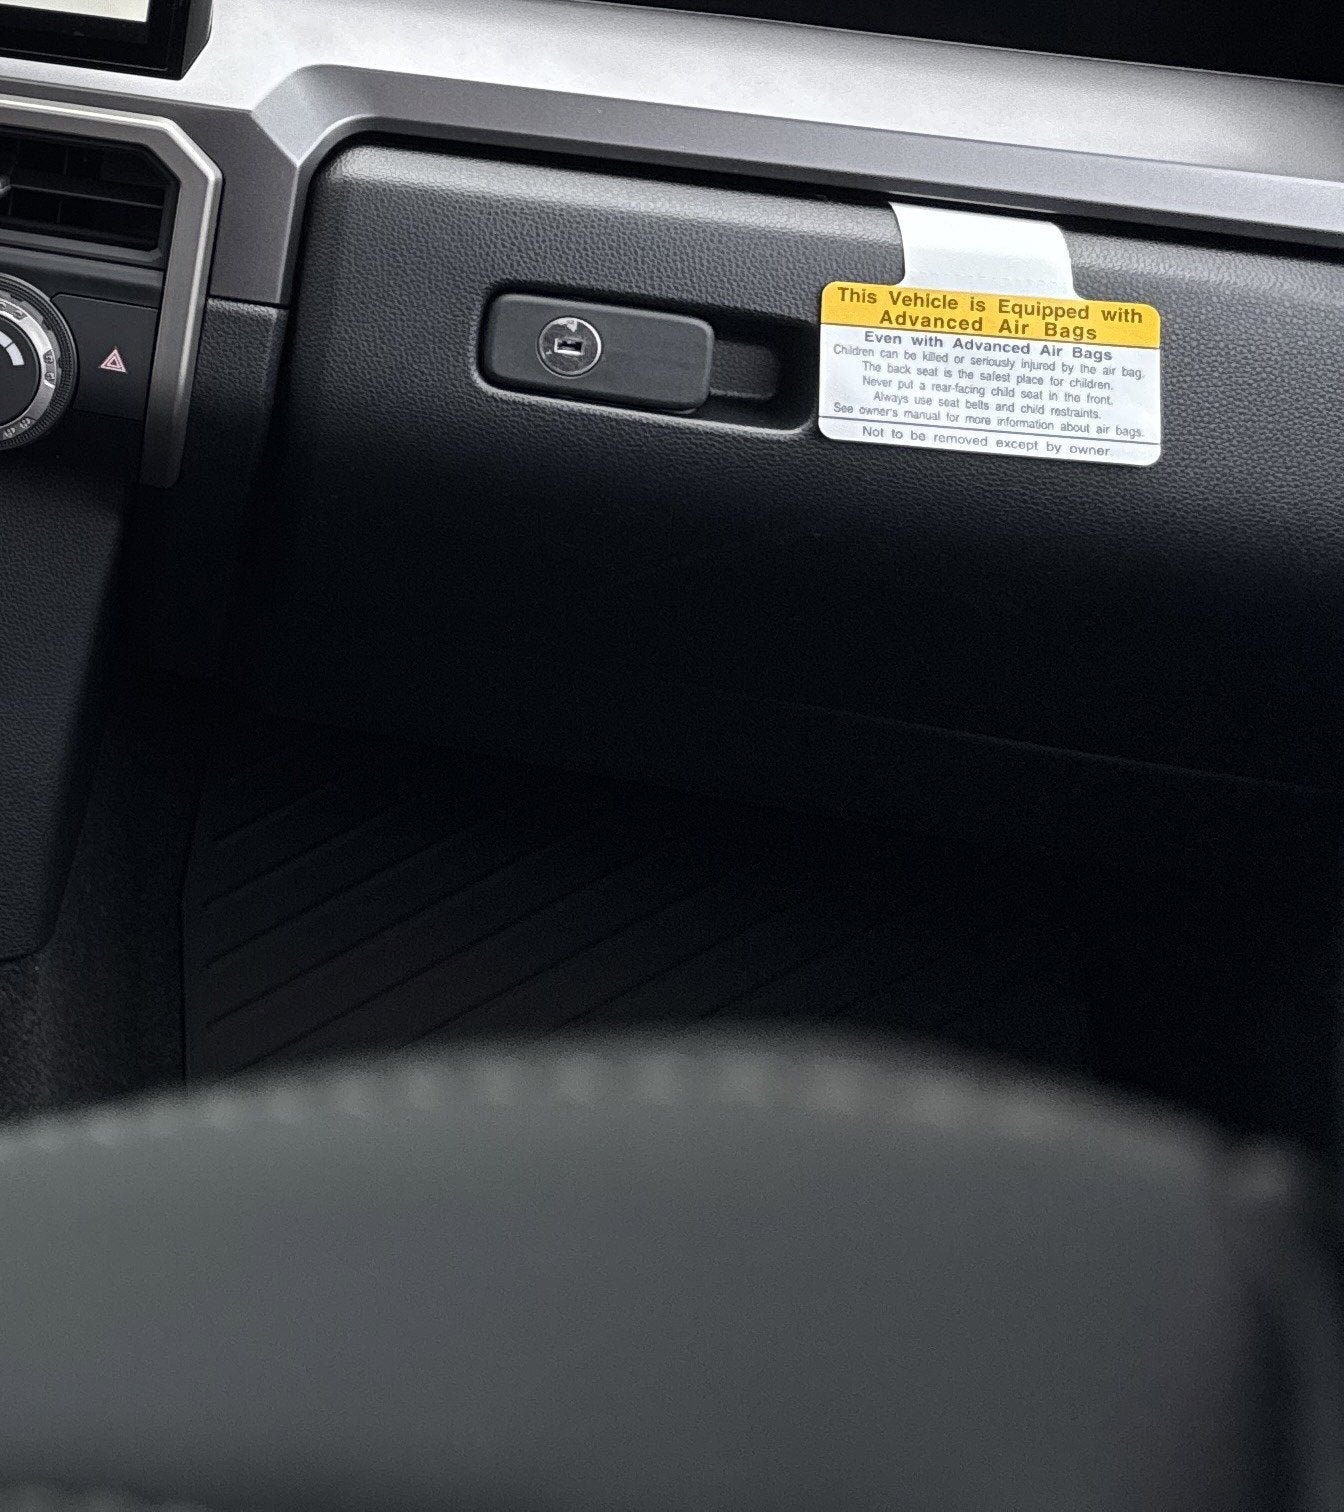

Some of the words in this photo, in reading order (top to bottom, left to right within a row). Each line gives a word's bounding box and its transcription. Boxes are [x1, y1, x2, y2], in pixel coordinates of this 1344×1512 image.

[837, 287, 877, 304] This
[888, 291, 959, 310] Vehicle
[970, 296, 986, 312] is
[998, 299, 1090, 320] Equipped
[1101, 309, 1143, 324] with
[879, 310, 983, 332] Advanced
[998, 319, 1029, 335] Air
[1044, 322, 1097, 341] Bags
[833, 344, 874, 357] Children
[880, 350, 898, 359] can
[954, 356, 965, 364] or
[971, 356, 1015, 370] seriously
[1022, 360, 1056, 372] injured
[1062, 363, 1074, 374] by
[1080, 364, 1096, 375] the
[1103, 366, 1115, 376] air
[864, 331, 902, 344] Even
[911, 335, 943, 348] with
[953, 337, 1030, 355] Advanced
[1040, 344, 1063, 357] Air
[1072, 347, 1112, 363] Bags
[862, 360, 881, 372] The
[887, 363, 911, 374] back
[917, 366, 938, 377] seat
[944, 368, 952, 378] is
[958, 369, 973, 379] the
[980, 371, 1010, 383] safest
[1016, 374, 1043, 386] place
[1050, 375, 1064, 386] for
[862, 376, 892, 388] Never
[898, 379, 913, 391] put
[931, 382, 985, 398] rear-facing
[991, 387, 1015, 398] child
[1021, 390, 1043, 400] seat
[1049, 391, 1058, 401] in
[1064, 392, 1080, 402] the
[873, 391, 909, 405] Always
[914, 396, 932, 405] use
[938, 398, 959, 408] seat
[965, 399, 989, 410] belts
[995, 402, 1015, 412] and
[1020, 404, 1044, 414] child
[834, 402, 853, 413] See
[859, 405, 898, 417] owner's
[903, 409, 941, 421] manual
[946, 413, 959, 423] for
[965, 416, 991, 425] more
[997, 417, 1054, 430] information
[1061, 422, 1090, 433] about
[1096, 424, 1110, 434] air
[862, 426, 884, 437] Not
[891, 429, 903, 439] to
[911, 431, 925, 441] be
[933, 433, 988, 447] removed
[997, 439, 1039, 451] except
[1046, 441, 1062, 454] by
